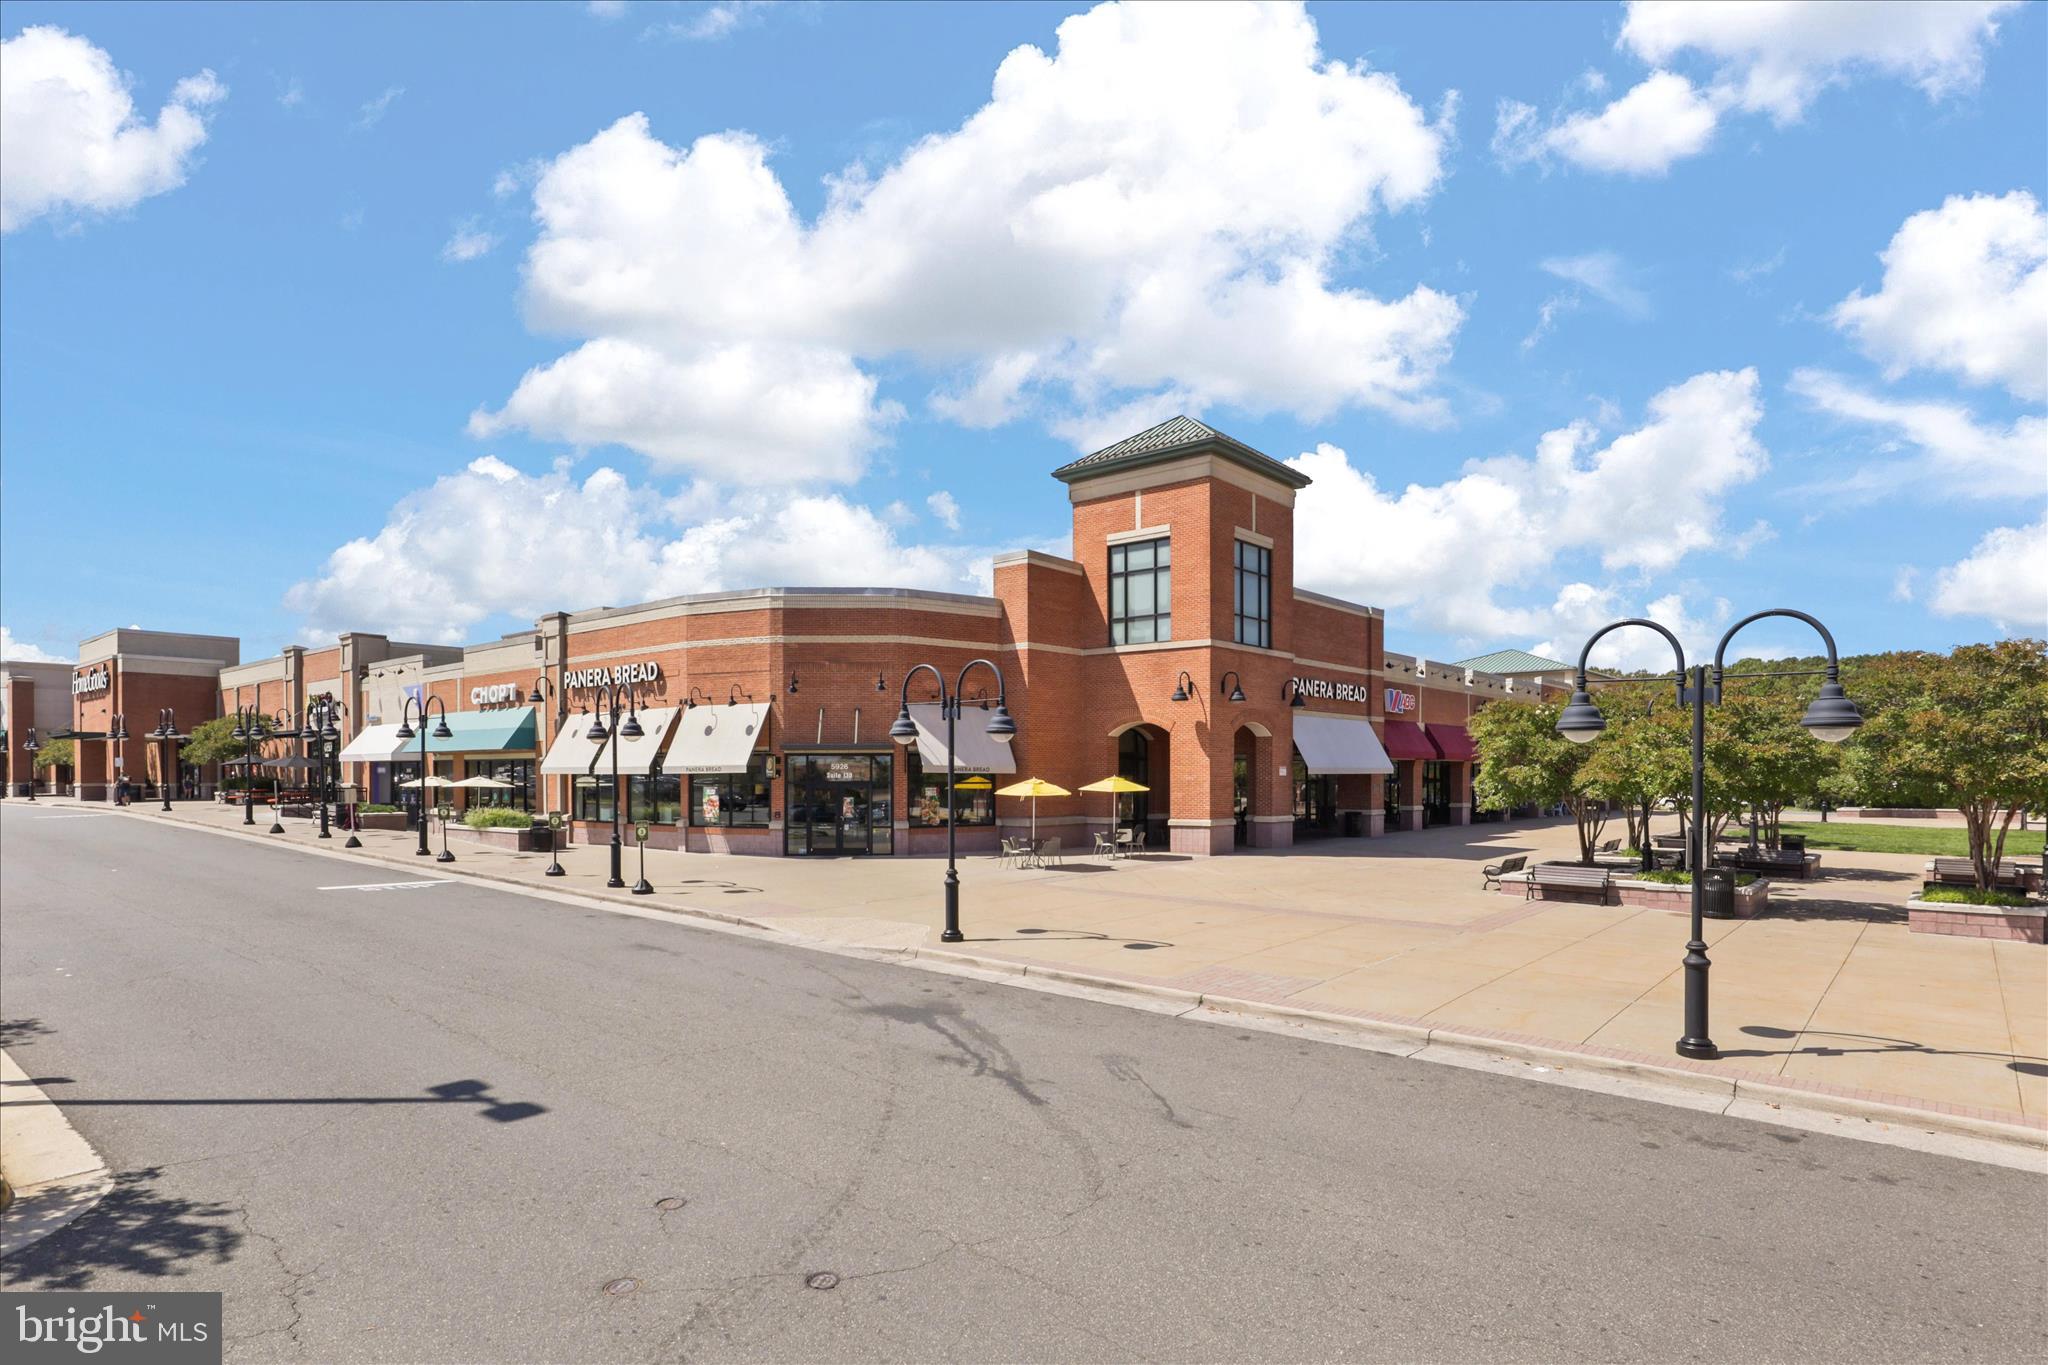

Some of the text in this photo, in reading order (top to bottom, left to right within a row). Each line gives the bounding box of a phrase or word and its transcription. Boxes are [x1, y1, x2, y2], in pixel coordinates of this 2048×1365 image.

[72, 663, 108, 695] HomeGoods
[564, 661, 658, 689] PANERA BREAD
[471, 682, 516, 705] CHOPT
[1292, 677, 1334, 699] PANERA
[1336, 683, 1367, 702] BREAD
